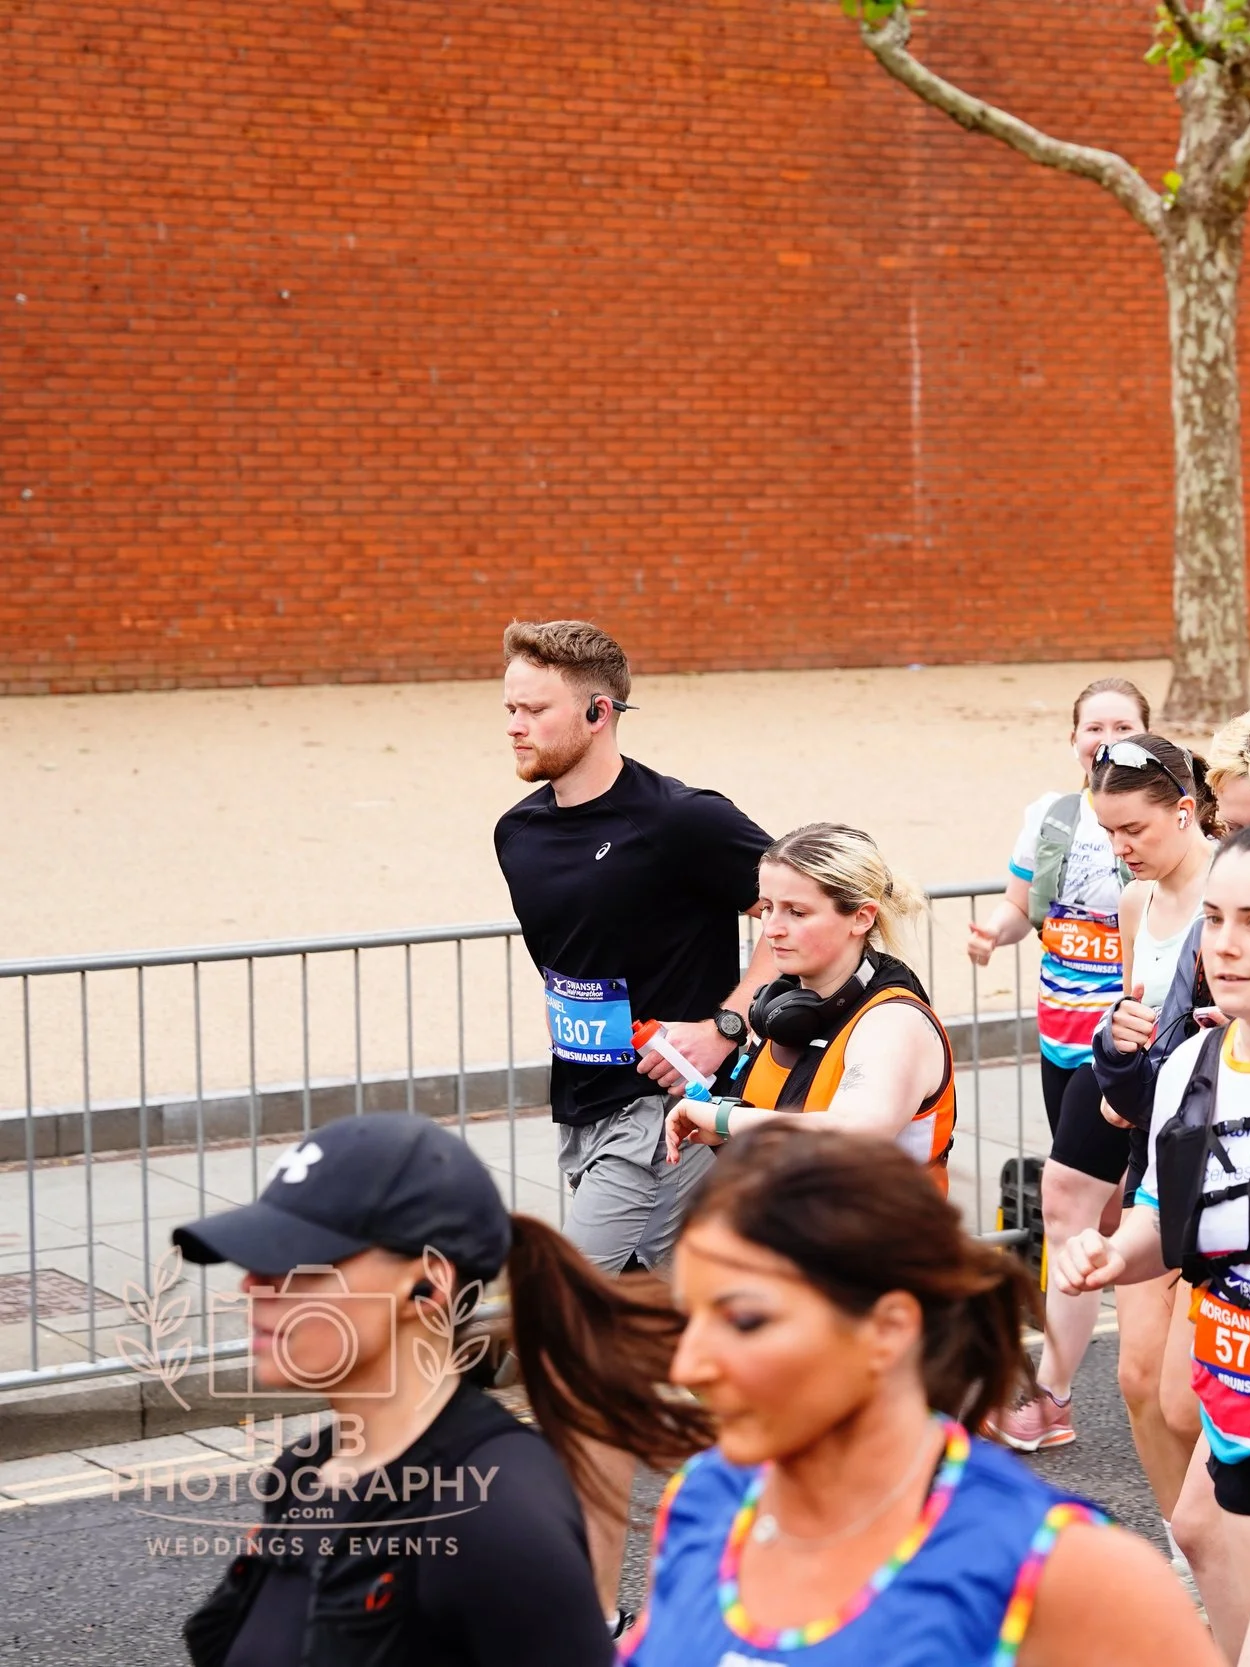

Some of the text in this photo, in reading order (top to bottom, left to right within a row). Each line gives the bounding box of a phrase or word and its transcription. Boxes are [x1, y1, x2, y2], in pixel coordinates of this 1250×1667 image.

[1045, 921, 1079, 933] ALICIA
[1060, 933, 1118, 960] 5215
[567, 981, 602, 991] SWANSEA
[545, 994, 567, 1014] DANIEL
[555, 1014, 606, 1046] 1307
[1200, 1298, 1250, 1331] MORGAN
